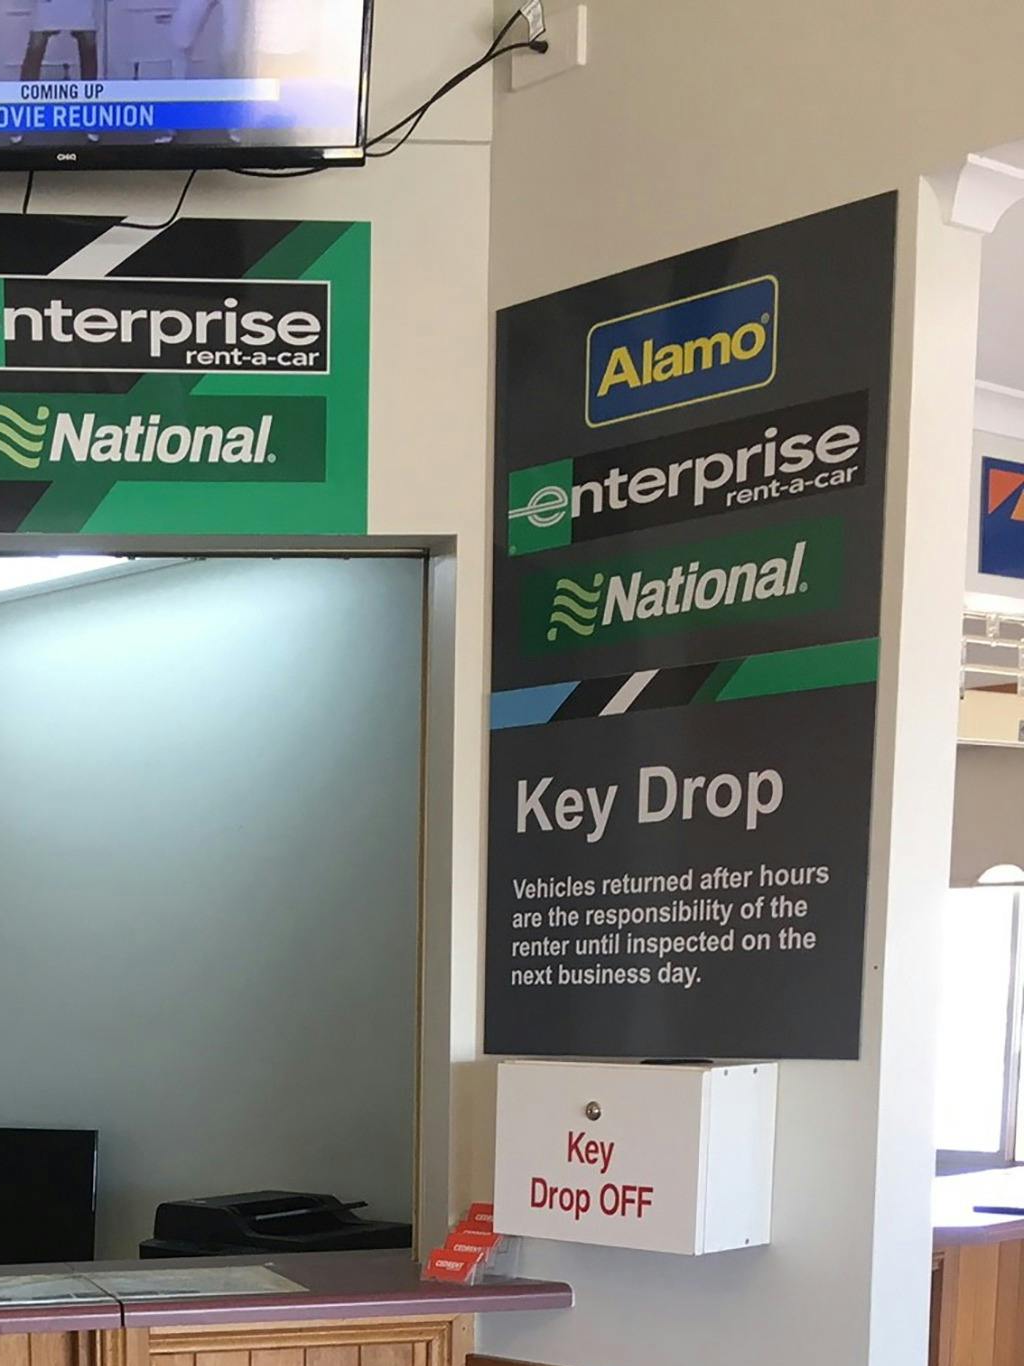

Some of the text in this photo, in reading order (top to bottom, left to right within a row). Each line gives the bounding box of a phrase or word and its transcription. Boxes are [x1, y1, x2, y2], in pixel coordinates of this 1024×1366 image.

[20, 84, 104, 100] COMING UP
[53, 105, 155, 127] REUNION
[185, 345, 320, 367] rent-a-car
[596, 321, 766, 397] Alamo
[49, 412, 272, 464] National
[508, 424, 861, 527] enterprise
[726, 463, 858, 507] rent-a-car
[601, 541, 807, 625] National
[516, 765, 784, 843] Key Drop
[513, 864, 829, 899] Vehicles returned after hours
[512, 895, 808, 930] are the responsibility of the
[512, 927, 817, 958] renter until inspected on the
[511, 961, 702, 989] next business day.
[567, 1131, 615, 1174] Key
[530, 1178, 654, 1220] Drop OFF
